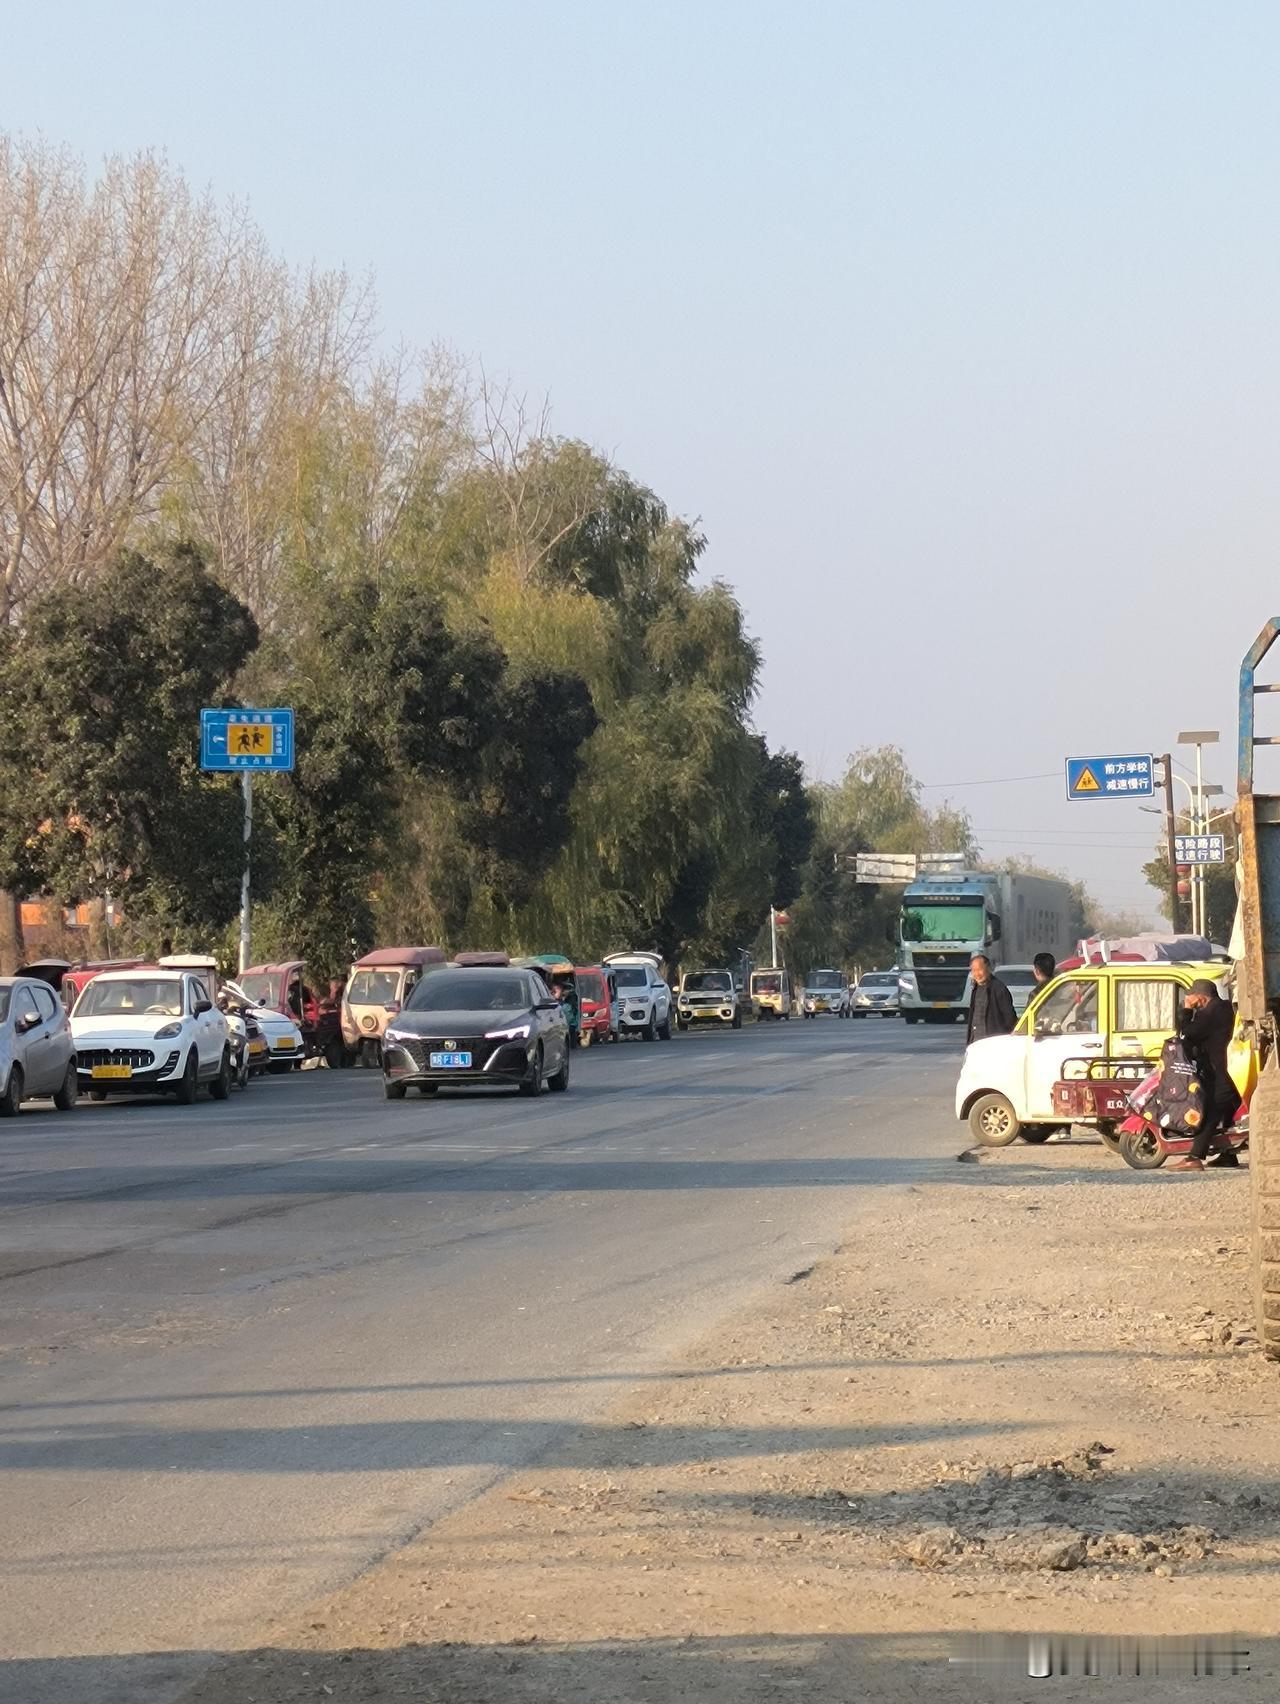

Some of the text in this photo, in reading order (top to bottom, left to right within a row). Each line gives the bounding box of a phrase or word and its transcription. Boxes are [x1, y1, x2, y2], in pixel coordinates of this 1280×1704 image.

[1105, 762, 1148, 774] 前方学校
[1106, 777, 1149, 790] 减速慢行
